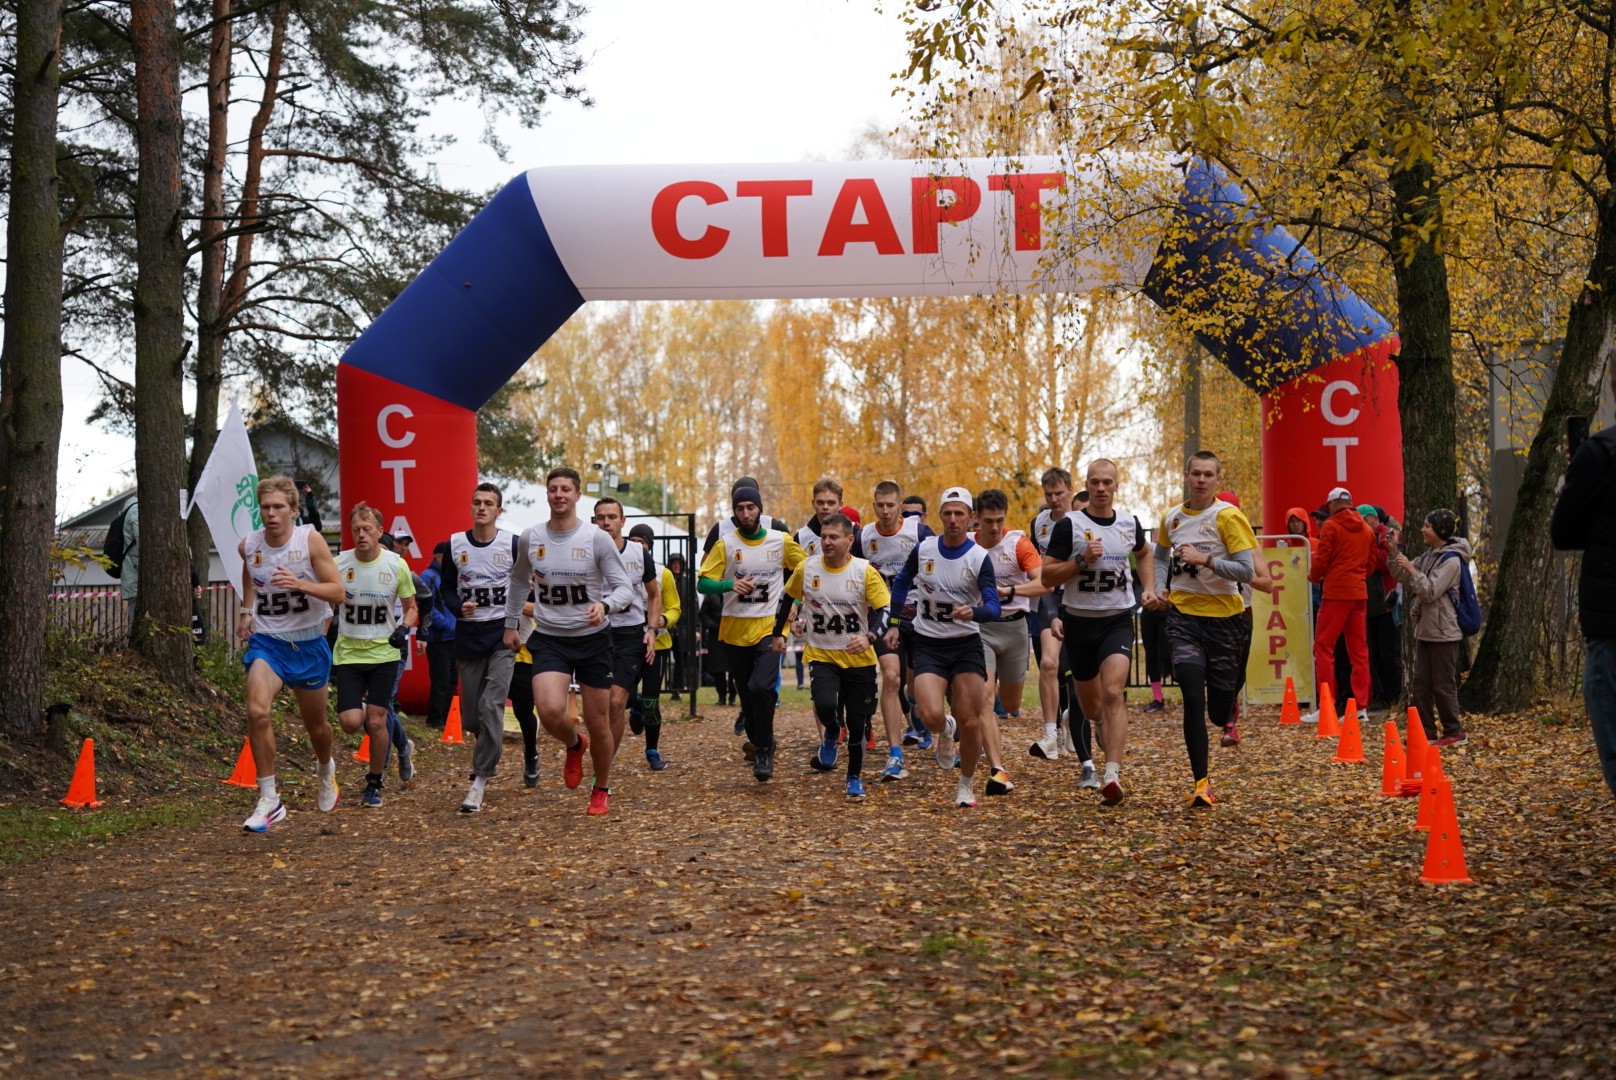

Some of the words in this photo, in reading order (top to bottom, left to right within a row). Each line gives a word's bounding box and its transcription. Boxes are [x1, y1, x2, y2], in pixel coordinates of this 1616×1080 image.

[651, 172, 1066, 260] СТАРТ
[1079, 570, 1128, 592] 254
[256, 590, 310, 616] 253
[538, 583, 590, 605] 290
[344, 604, 388, 625] 206
[922, 599, 956, 622] 12
[1265, 560, 1288, 679] СТАРТ
[812, 613, 860, 635] 248
